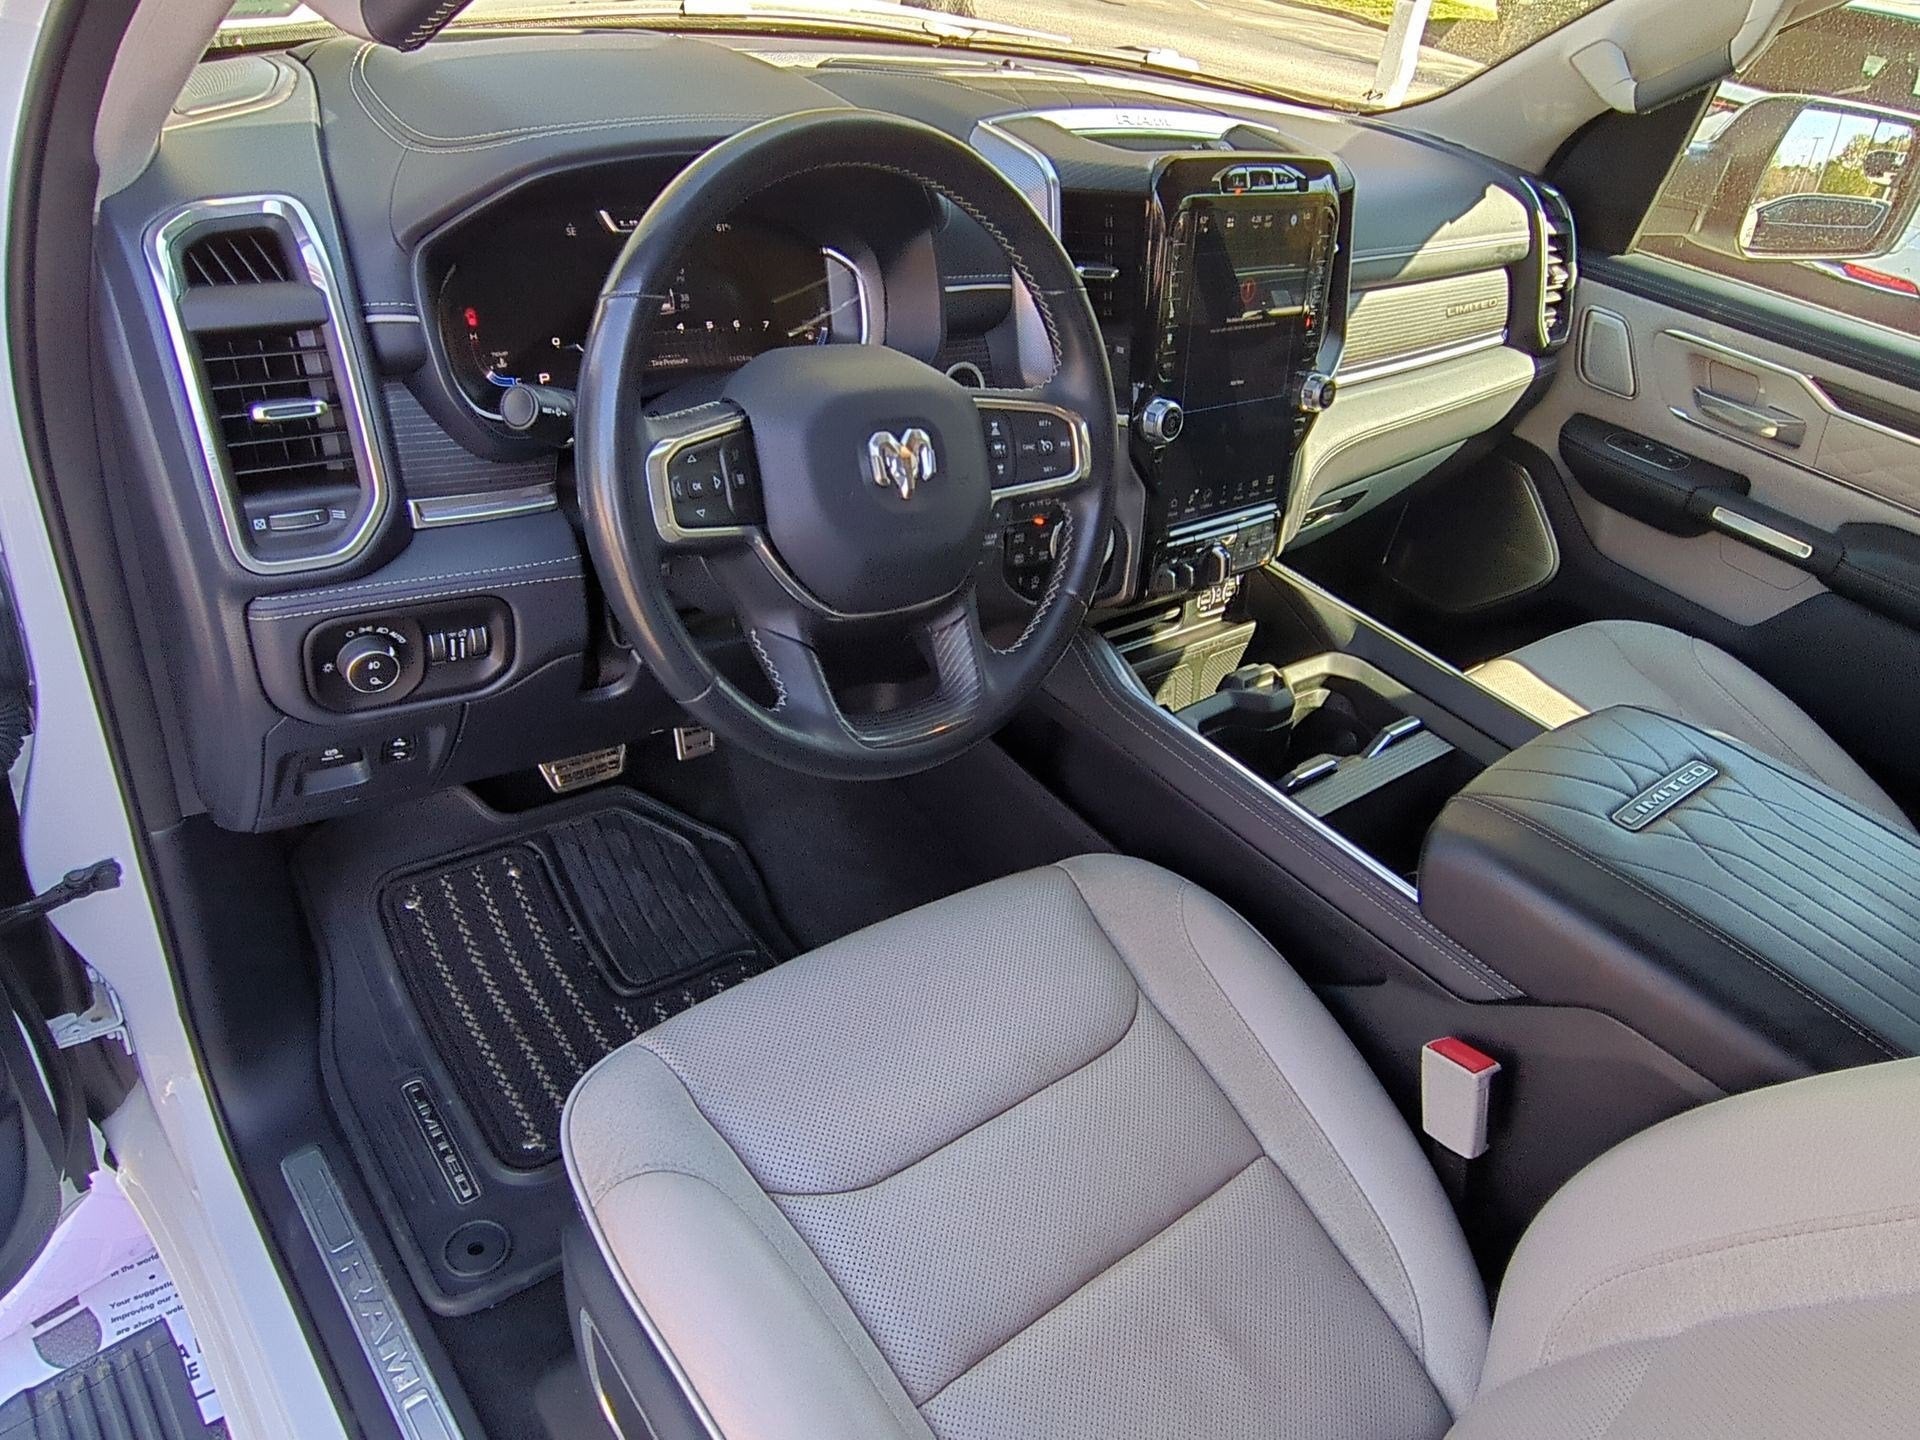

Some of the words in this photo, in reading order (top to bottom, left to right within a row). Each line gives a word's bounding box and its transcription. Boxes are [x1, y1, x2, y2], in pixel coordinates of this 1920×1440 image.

[1445, 297, 1499, 317] LIMITED
[676, 322, 685, 331] 4
[705, 320, 714, 329] 5
[732, 319, 741, 329] 6
[762, 320, 771, 329] 7
[539, 372, 550, 384] P
[692, 482, 702, 491] OK
[389, 631, 407, 644] AUTO
[1620, 764, 1710, 825] LIMITED
[406, 1084, 475, 1200] LIMITED
[120, 1263, 135, 1274] the
[136, 1252, 160, 1267] world
[109, 1297, 131, 1310] Your
[157, 1294, 172, 1306] our
[115, 1326, 131, 1336] are
[340, 1260, 421, 1394] RAM
